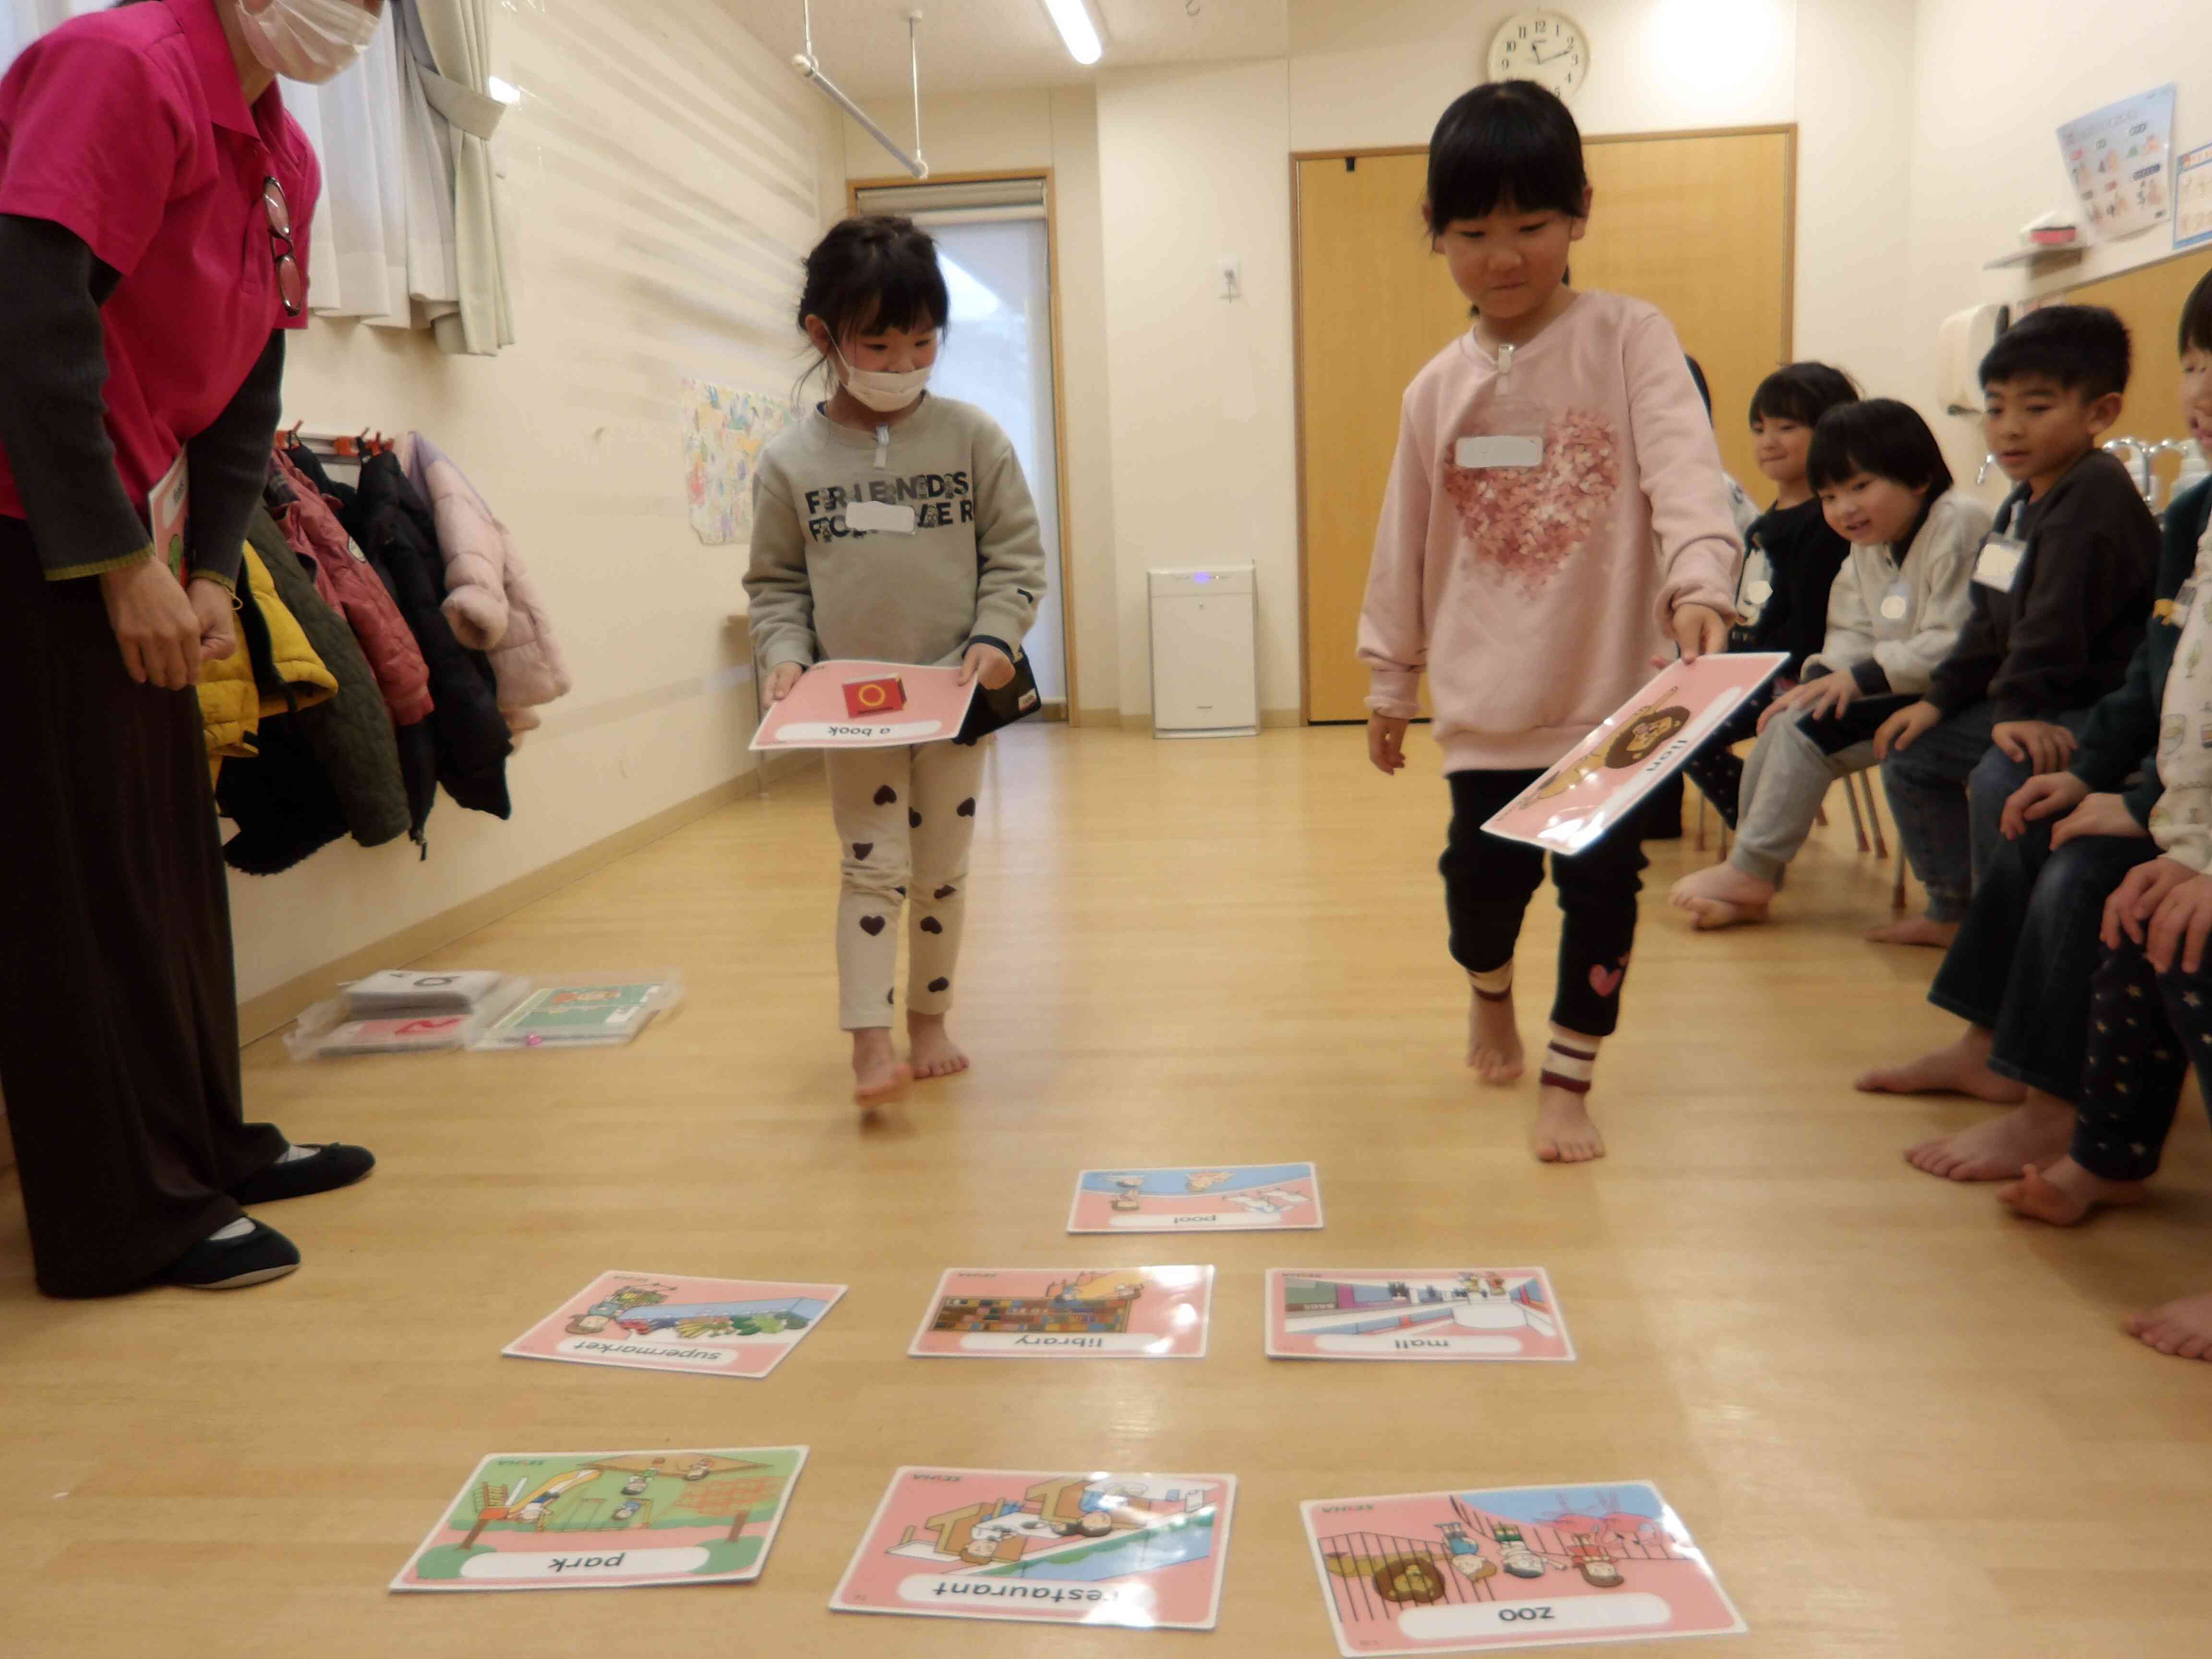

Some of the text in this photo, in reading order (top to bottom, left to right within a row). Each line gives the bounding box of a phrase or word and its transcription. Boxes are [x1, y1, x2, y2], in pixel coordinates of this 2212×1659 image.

[1518, 26, 1527, 38] 11
[1535, 21, 1546, 32] 12
[1555, 24, 1559, 36] 1
[1506, 40, 1516, 52] 10
[1566, 37, 1574, 49] 2
[1502, 58, 1509, 70] 9
[1572, 54, 1578, 65] 3
[1564, 72, 1571, 83] 4
[805, 471, 969, 515] FRIENDS
[828, 725, 873, 736] book
[1646, 739, 1688, 772] lion
[1174, 1214, 1216, 1225] pool
[1015, 1334, 1103, 1348] library
[1395, 1338, 1449, 1349] mall
[574, 1341, 722, 1359] supermarket
[549, 1552, 625, 1573] park
[1498, 1606, 1555, 1622] zoo
